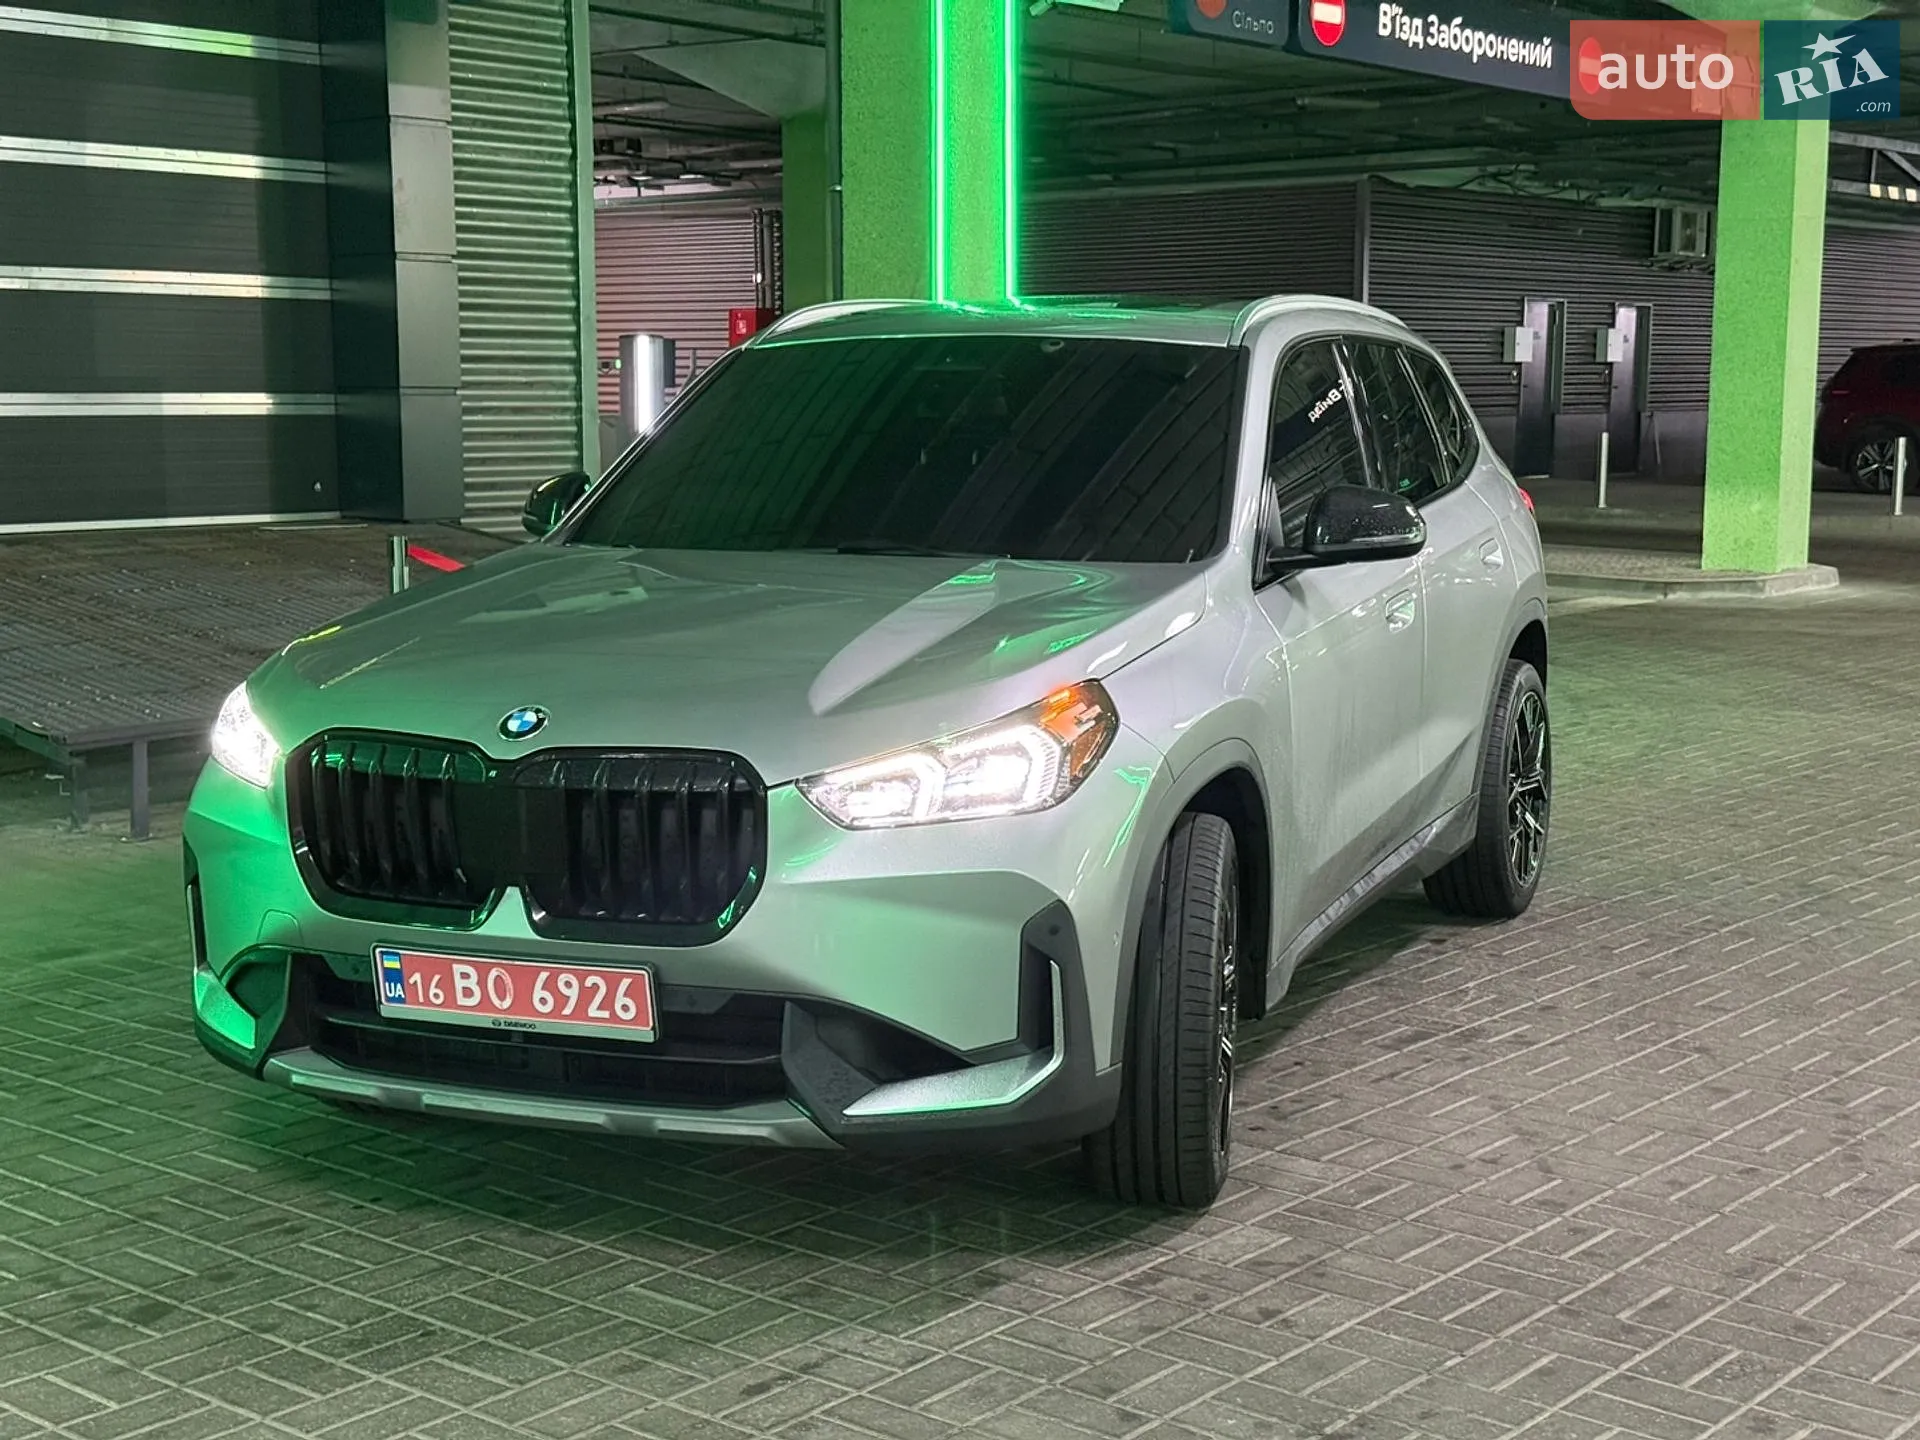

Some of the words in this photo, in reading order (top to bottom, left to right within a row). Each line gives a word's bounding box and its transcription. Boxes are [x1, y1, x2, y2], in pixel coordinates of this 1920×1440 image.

[1232, 10, 1274, 34] Сільпо
[1378, 3, 1424, 49] В'їзд
[1427, 14, 1552, 69] Заборонений
[385, 982, 405, 998] UA
[408, 972, 445, 1005] 16
[452, 963, 514, 1010] BO
[532, 971, 637, 1021] 6926
